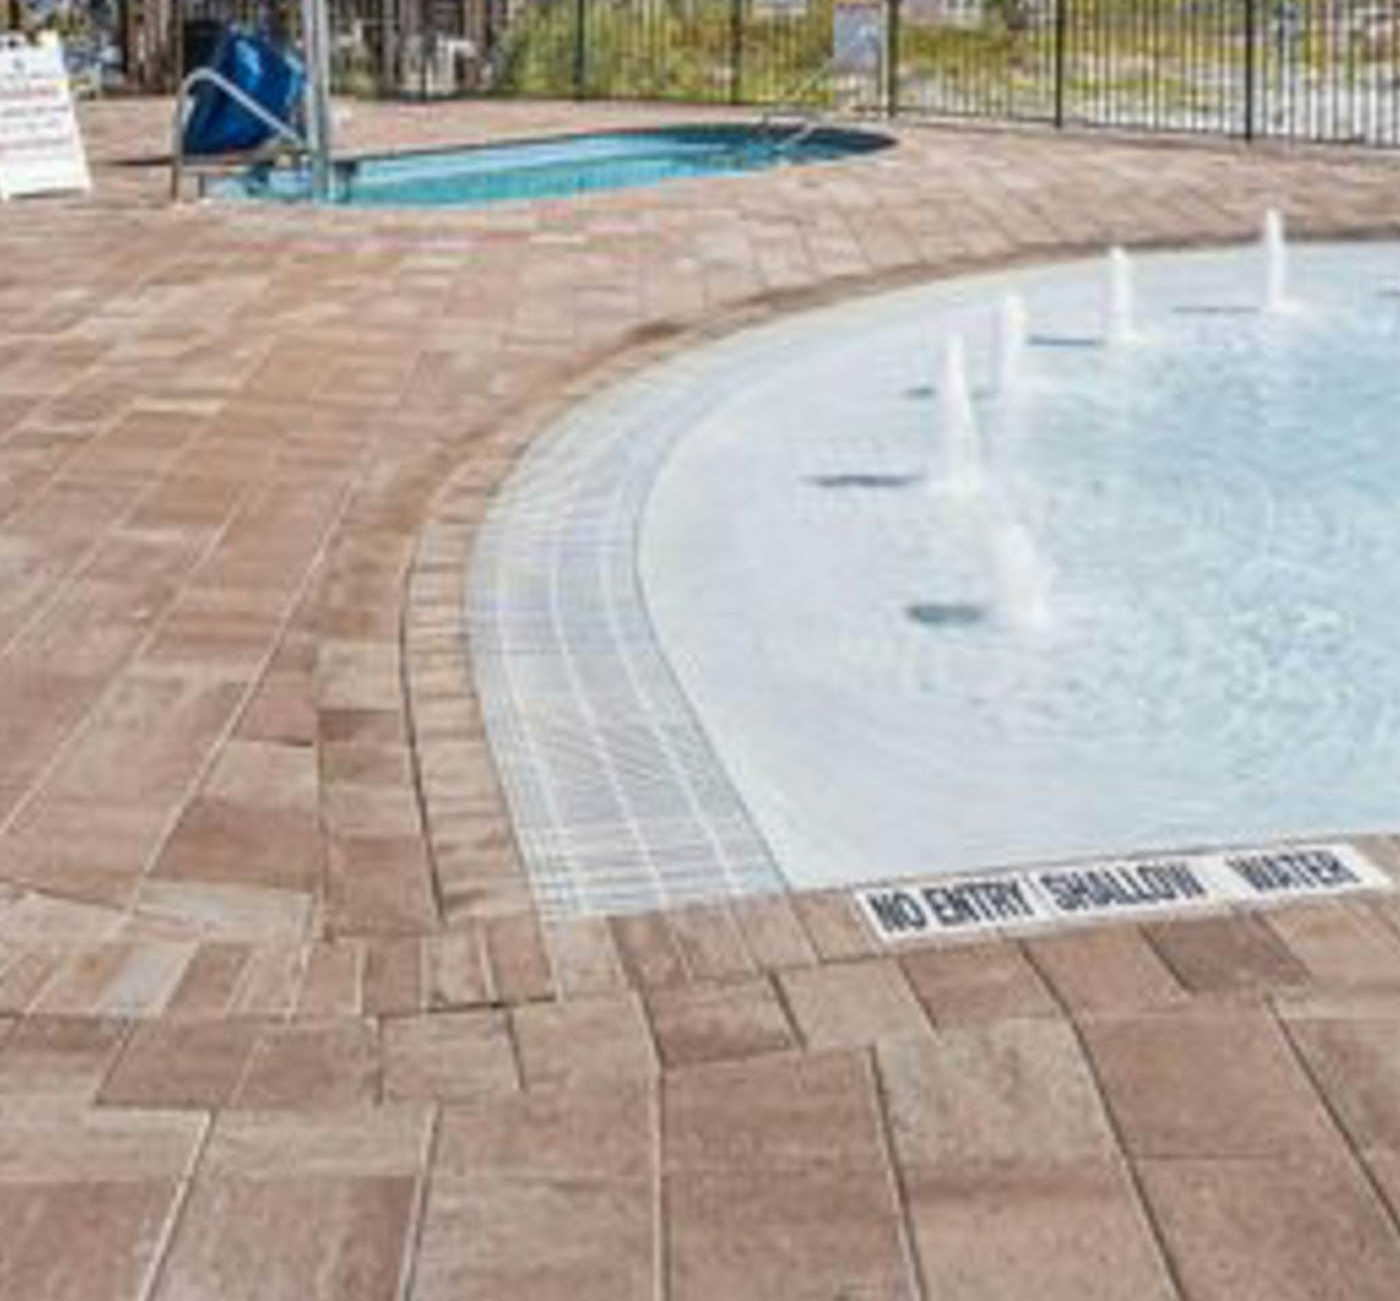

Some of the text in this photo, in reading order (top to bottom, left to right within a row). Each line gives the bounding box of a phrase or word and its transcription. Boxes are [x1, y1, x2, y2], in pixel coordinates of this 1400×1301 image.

[867, 850, 1360, 932] NO ENTRY SHALLOW WATER
